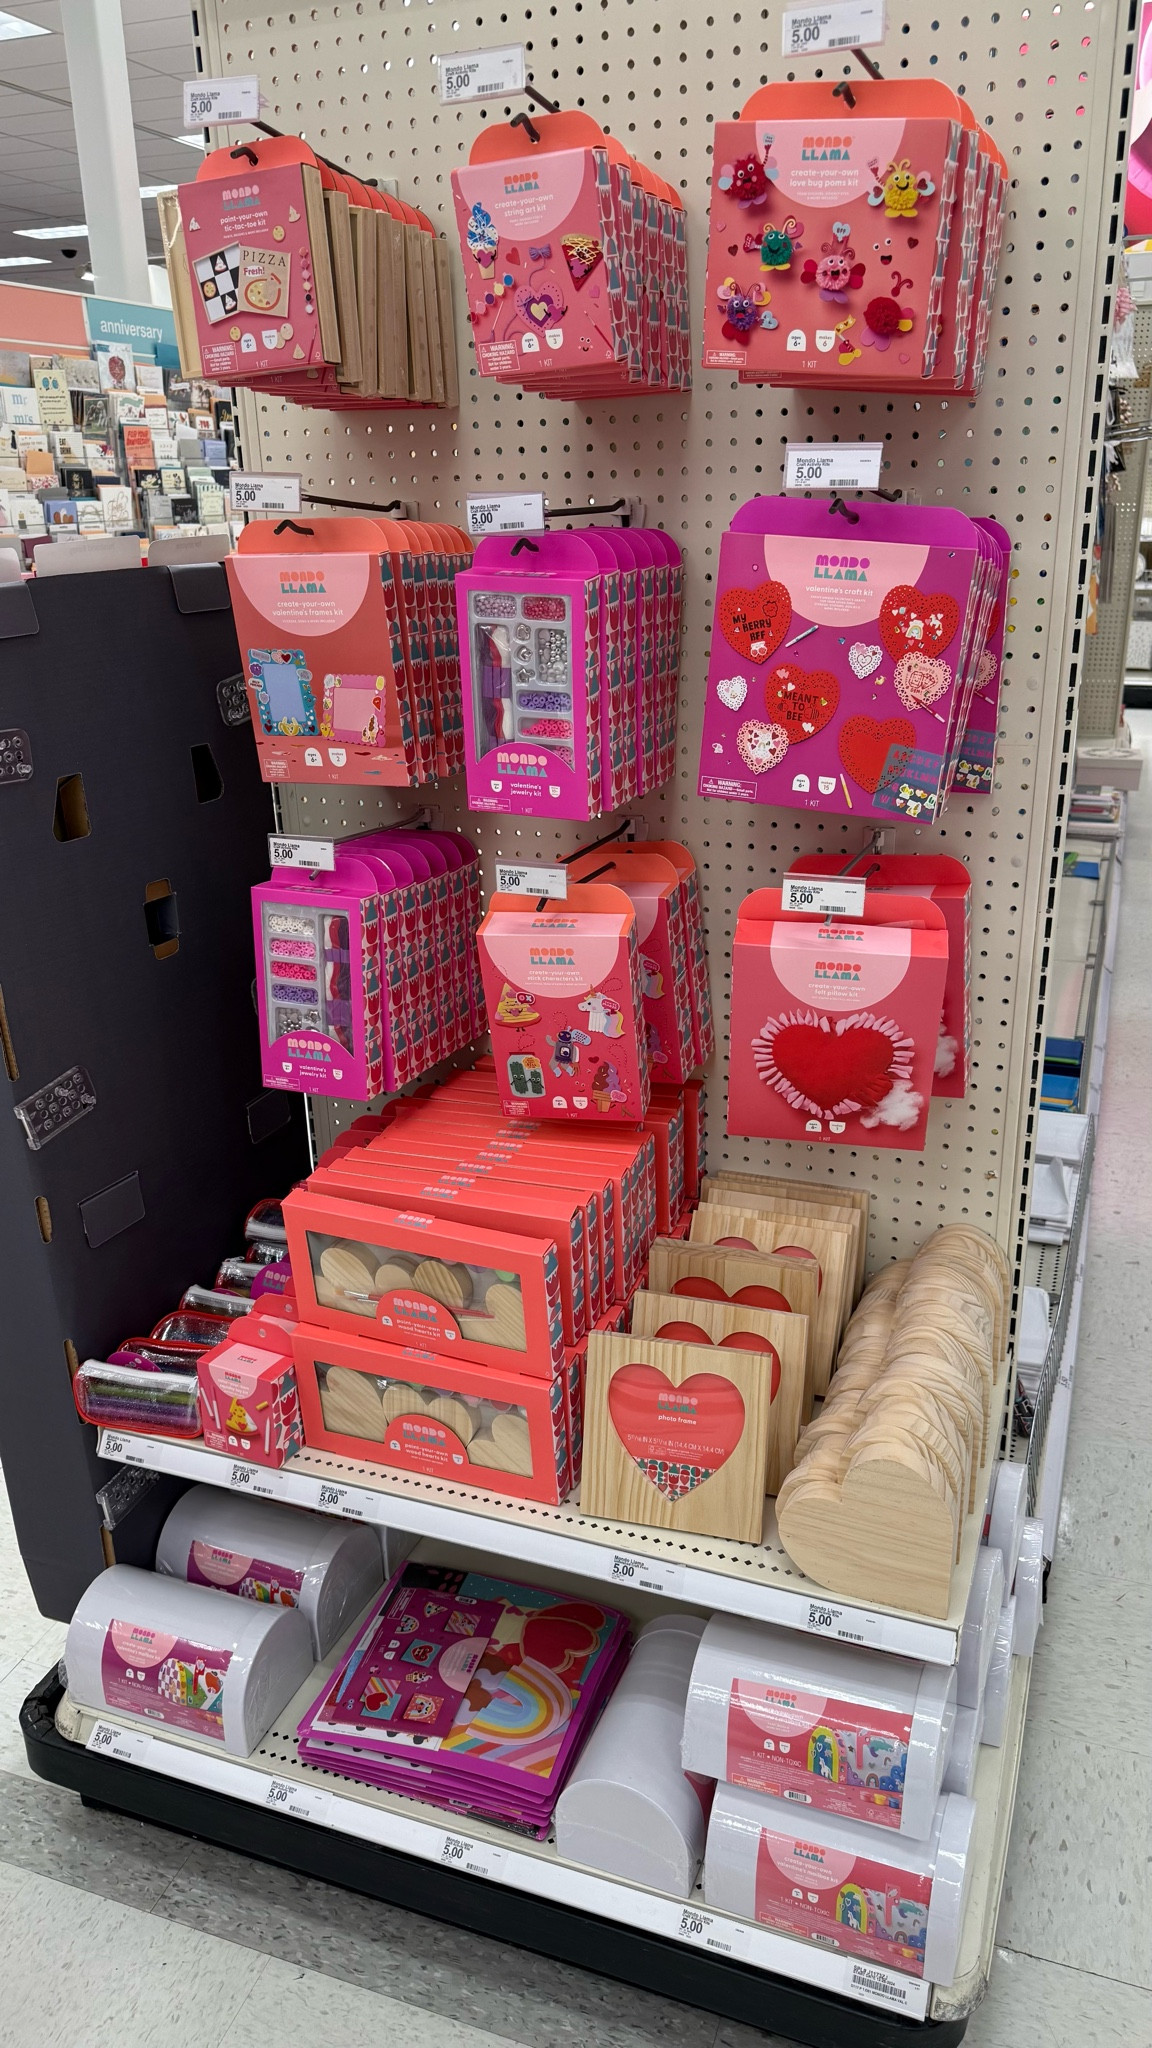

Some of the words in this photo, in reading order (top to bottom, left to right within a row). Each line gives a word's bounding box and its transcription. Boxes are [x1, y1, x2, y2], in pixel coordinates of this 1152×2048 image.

[792, 17, 812, 25] Mondo
[813, 14, 832, 22] Llama
[792, 27, 820, 44] 5.00
[446, 65, 461, 73] Mondo
[463, 62, 480, 70] Llama
[446, 74, 470, 90] 5.00
[190, 101, 212, 114] 5.00
[803, 136, 852, 148] MONDO
[802, 149, 850, 161] LLAMA
[504, 172, 538, 184] MONDO
[791, 169, 858, 179] create-your-own
[504, 182, 540, 194] LLAMA
[790, 179, 805, 187] love
[806, 179, 823, 189] bug
[825, 180, 846, 189] poms
[848, 178, 858, 187] kit
[222, 185, 260, 200] MONDO
[224, 197, 260, 210] LLAMA
[495, 194, 554, 209] create-your-own
[220, 210, 268, 224] paint-your-own
[504, 208, 524, 218] string
[526, 206, 536, 214] art
[536, 204, 546, 212] kit
[224, 222, 256, 232] tic-tac-toe
[258, 220, 266, 228] kit
[243, 250, 286, 267] PIZZA
[244, 267, 264, 276] Fresh!
[100, 318, 162, 342] anniversary
[544, 358, 553, 366] KIT
[796, 467, 822, 478] 5.00
[236, 490, 256, 501] 5.00
[472, 513, 493, 524] 5.00
[816, 554, 870, 569] MONDO
[280, 571, 324, 582] MONDO
[814, 568, 868, 582] LLAMA
[281, 583, 326, 594] LLAMA
[806, 585, 843, 595] valentine's
[844, 587, 862, 596] craft
[278, 601, 336, 609] create-your-own
[272, 608, 308, 616] valentine's
[732, 613, 746, 625] MY
[742, 618, 772, 632] BERRY
[784, 692, 819, 704] MEANT
[792, 702, 806, 712] TO
[786, 711, 803, 722] BEE
[497, 752, 548, 766] MONDO
[498, 764, 548, 778] LLAMA
[274, 849, 292, 858] 5.00
[500, 876, 520, 886] 5.00
[790, 893, 813, 904] 5.00
[530, 948, 574, 956] MONDO
[530, 956, 576, 966] LLAMA
[815, 961, 862, 972] MONDO
[529, 970, 580, 978] create-your-own
[814, 970, 860, 980] LLAMA
[808, 983, 865, 992] create-your-own
[827, 990, 848, 998] pillow
[288, 1038, 331, 1052] MONDO
[288, 1048, 332, 1062] LLAMA
[398, 1214, 434, 1224] MONDO
[394, 1298, 437, 1314] MONDO
[394, 1308, 438, 1322] LLAMA
[396, 1320, 440, 1332] paint-your-own
[414, 1328, 431, 1336] hearts
[659, 1393, 698, 1406] MONDO
[658, 1402, 697, 1414] LLAMA
[658, 1414, 676, 1422] photo
[678, 1416, 696, 1425] frame
[403, 1422, 446, 1438] MONDO
[403, 1431, 446, 1447] LLAMA
[106, 1441, 122, 1452] 5.00
[405, 1444, 448, 1456] paint-your-own
[406, 1449, 420, 1457] wood
[421, 1452, 438, 1461] hearts
[232, 1472, 250, 1483] 5.00
[320, 1492, 338, 1504] 5.00
[614, 1555, 630, 1564] Mondo
[630, 1558, 644, 1567] Llama
[613, 1564, 634, 1577] 5.00
[808, 1612, 832, 1626] 5.00
[766, 1690, 797, 1701] MONDO
[766, 1697, 796, 1708] LLAMA
[94, 1732, 112, 1745] 5.00
[772, 1755, 802, 1768] NON-TOXIC
[268, 1788, 287, 1802] 5.00
[446, 1836, 460, 1845] Mondo
[461, 1840, 474, 1848] Llama
[443, 1844, 463, 1858] 5.00
[795, 1842, 826, 1856] MONDO
[794, 1848, 824, 1863] LLAMA
[784, 1856, 832, 1874] create-your-own
[778, 1862, 808, 1873] valentine's
[808, 1868, 828, 1880] mailbox
[830, 1875, 838, 1883] kit
[800, 1902, 830, 1916] NON-TOXIC
[684, 1909, 698, 1918] Mondo
[699, 1914, 713, 1923] Llama
[680, 1918, 702, 1933] 5.00
